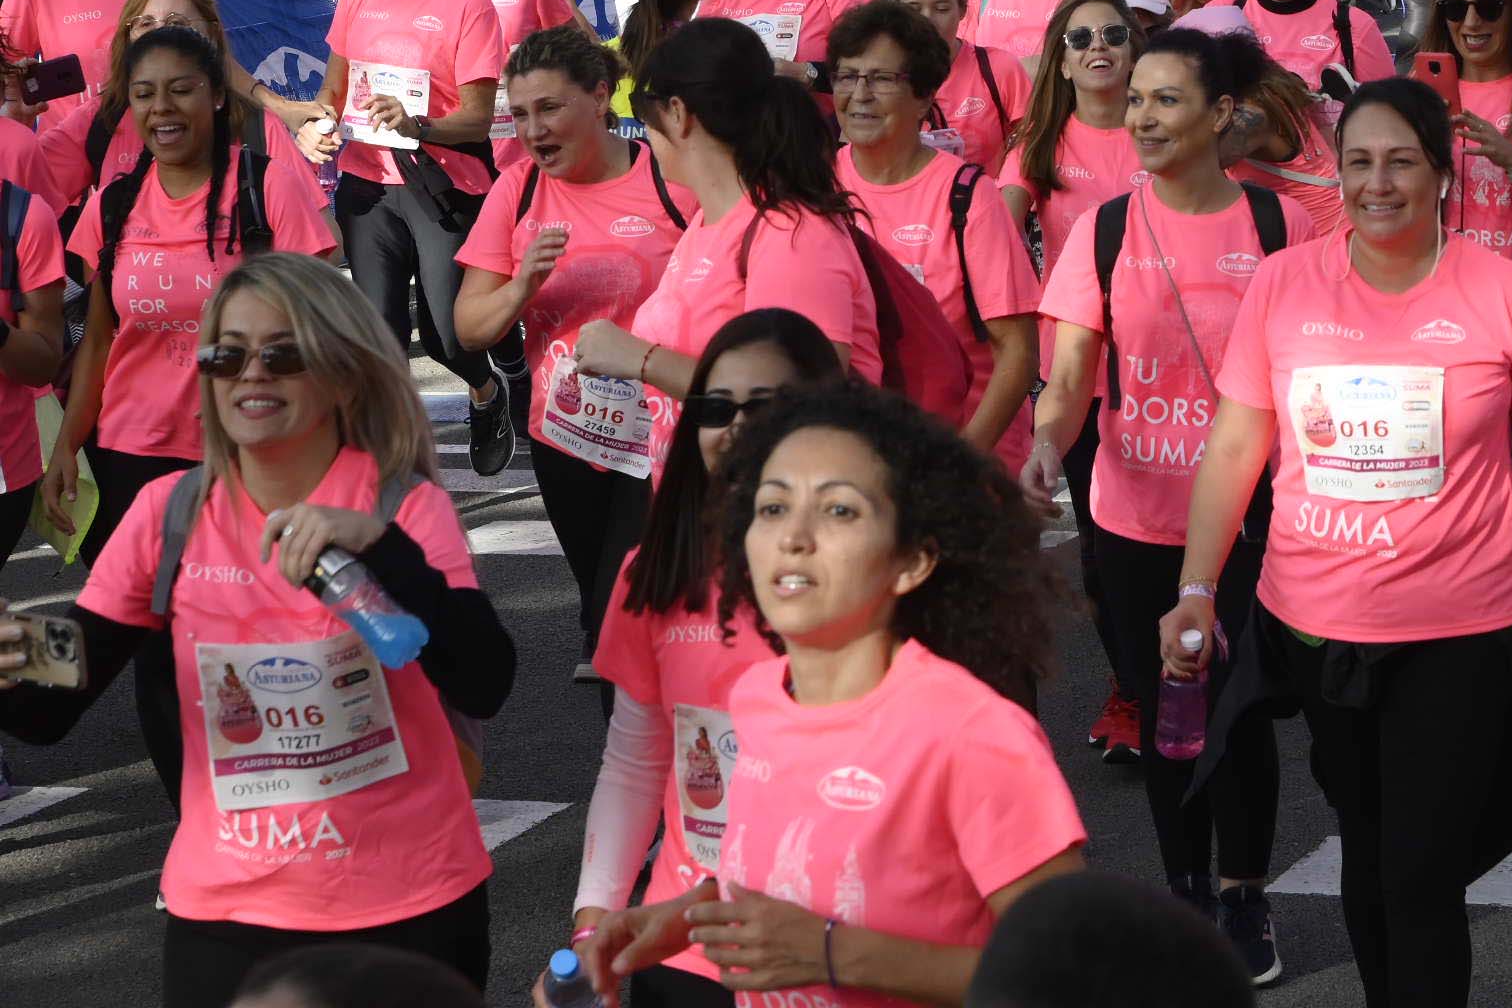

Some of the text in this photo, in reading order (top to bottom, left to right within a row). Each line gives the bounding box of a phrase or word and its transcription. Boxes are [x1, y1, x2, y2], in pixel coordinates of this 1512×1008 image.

[63, 10, 102, 26] OYSHO
[132, 252, 164, 266] WE
[129, 299, 168, 314] FOR
[135, 320, 199, 333] REASO
[1302, 322, 1364, 341] OYSHO
[1126, 355, 1159, 385] TU
[584, 403, 624, 423] 016
[1123, 394, 1217, 427] DORS
[584, 420, 616, 436] 27459
[1340, 420, 1389, 438] 016
[1349, 444, 1384, 455] 12354
[1363, 461, 1375, 470] LA
[1376, 460, 1406, 470] MUJER
[1314, 476, 1353, 488] OYSHO
[1386, 477, 1433, 488] Santander
[1295, 501, 1395, 547] SUMA
[186, 562, 256, 586] OYSHO
[265, 704, 325, 729] 016
[277, 734, 321, 749] 17277
[234, 756, 285, 770] CARRERA
[286, 754, 299, 767] DE
[301, 754, 314, 766] LA
[316, 747, 352, 764] MUJER
[332, 754, 390, 782] Santander
[232, 778, 290, 797] OYSHO
[217, 808, 345, 850] SUMA
[696, 823, 726, 835] CARRE
